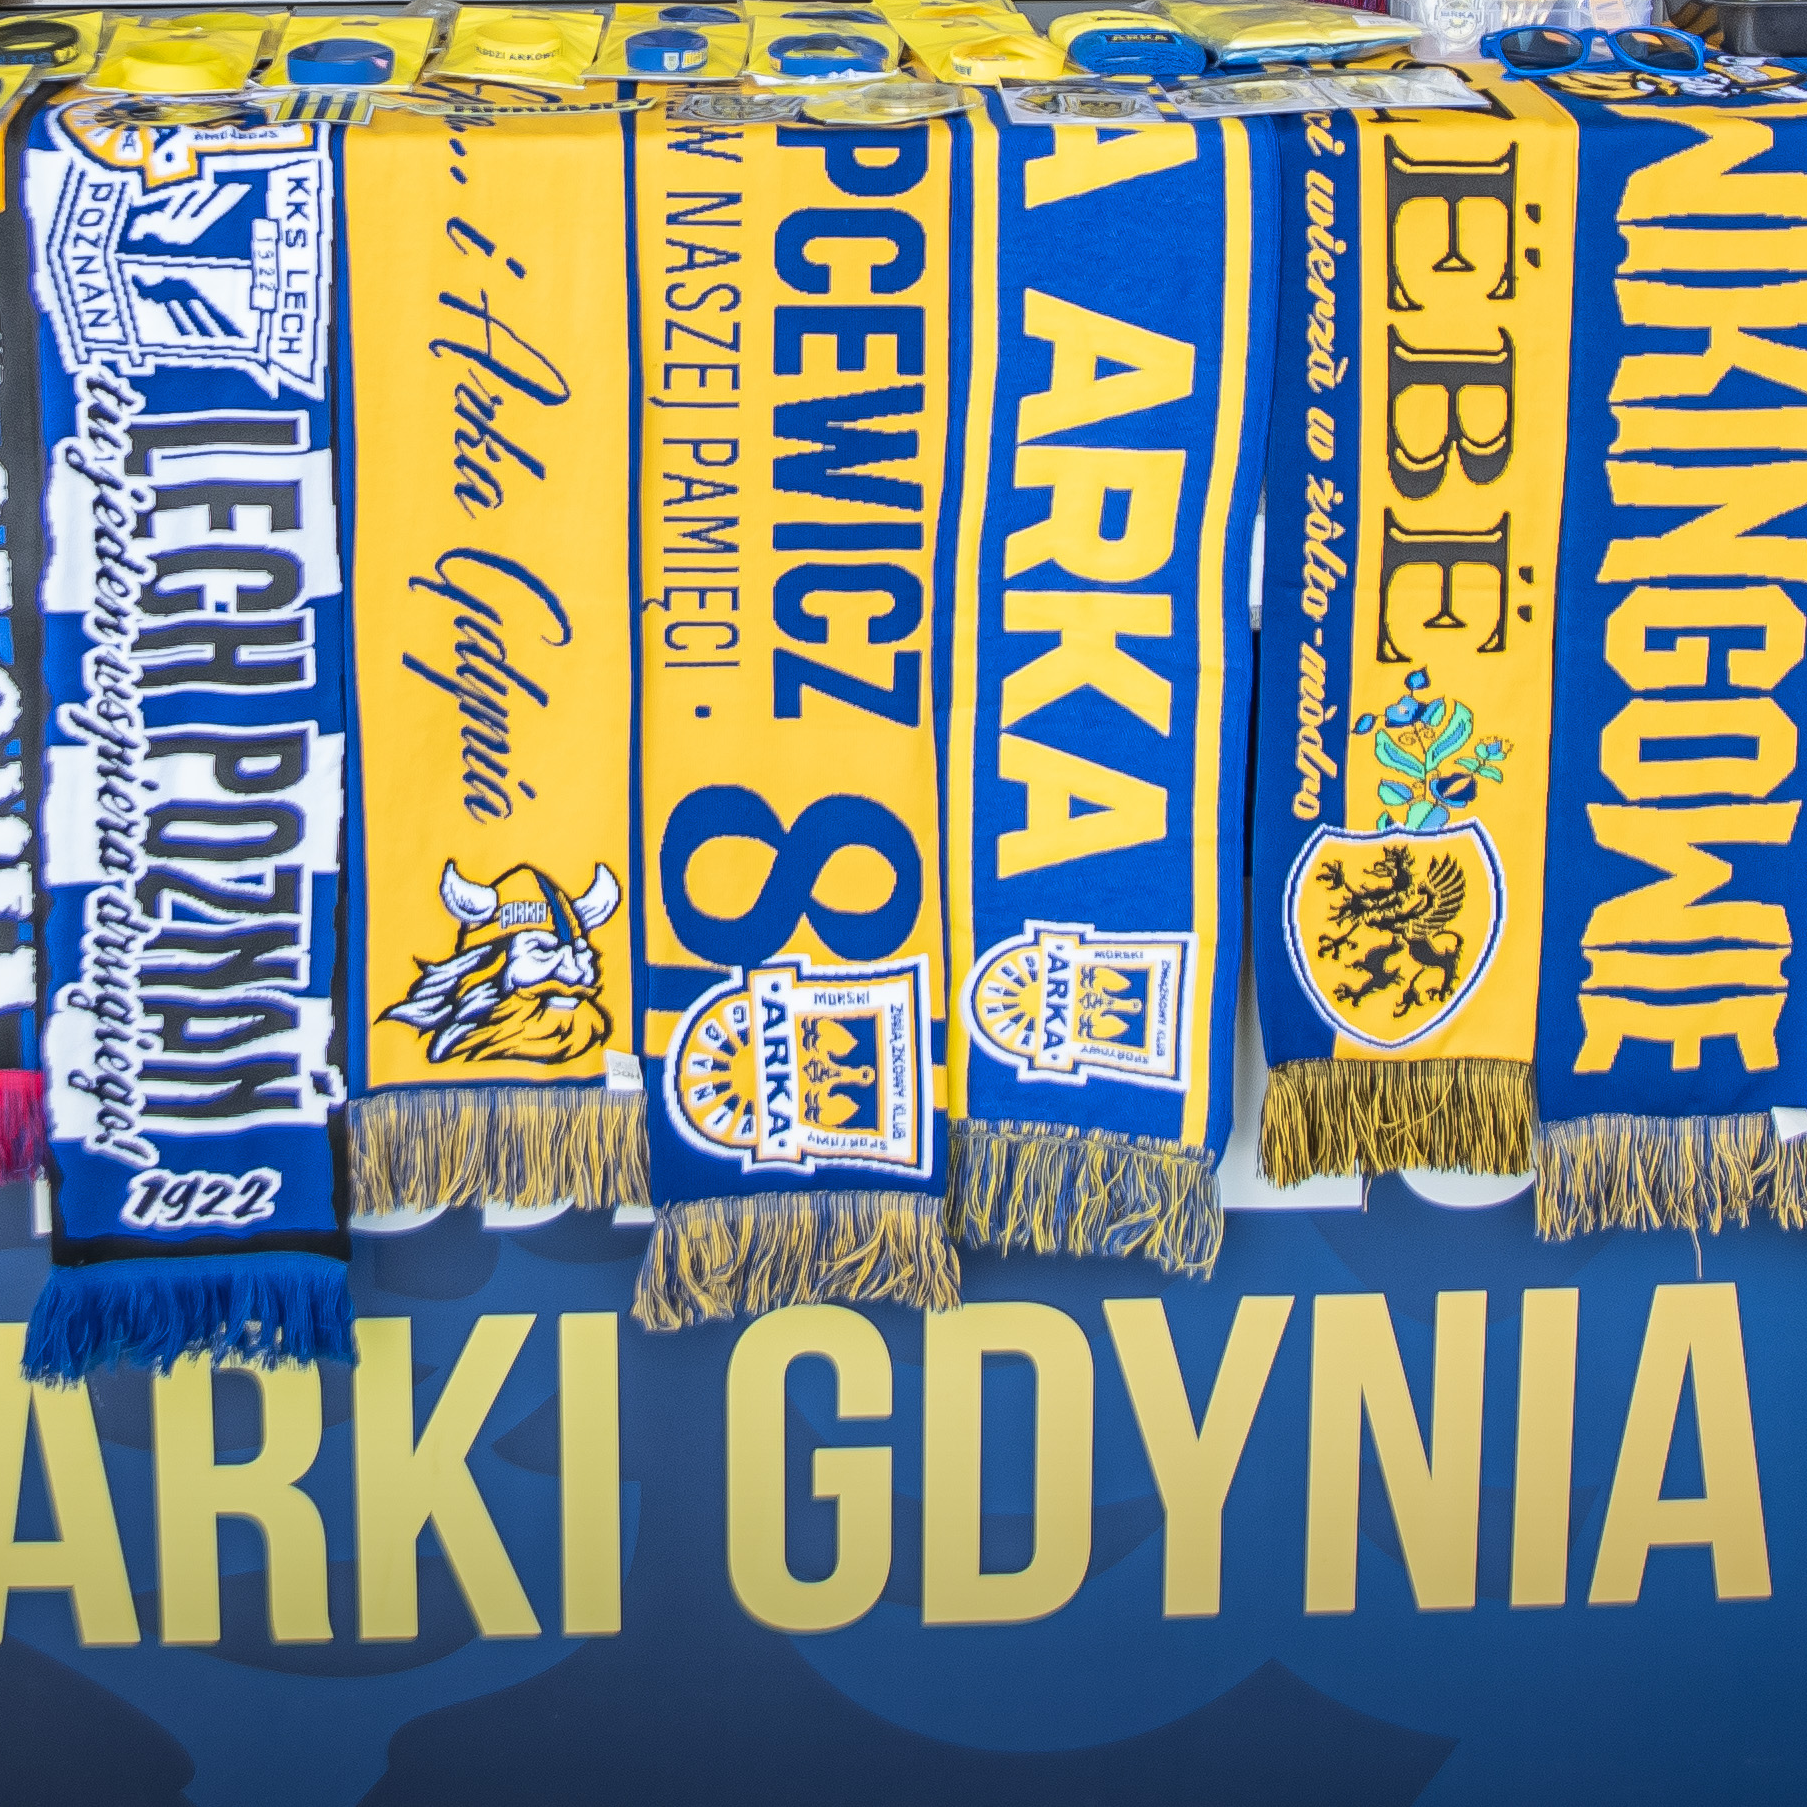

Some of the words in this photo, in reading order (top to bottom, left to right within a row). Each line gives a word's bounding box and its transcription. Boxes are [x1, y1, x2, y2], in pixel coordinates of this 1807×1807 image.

[285, 176, 311, 247] KKS
[446, 215, 527, 279] i
[647, 192, 742, 410] NASZEJ
[279, 269, 310, 355] LECH
[429, 290, 573, 519] Arka
[1376, 135, 1541, 664] ËBË
[86, 376, 134, 449] tu
[772, 125, 931, 728] PCEWICZ
[1306, 406, 1335, 461] w
[65, 445, 145, 635] jeden
[127, 413, 313, 689] LECH
[641, 438, 739, 668] PAMIĘCI
[998, 289, 1196, 880] ARKA
[69, 656, 158, 874] wspiera
[401, 546, 574, 825] Gdynia
[133, 733, 343, 1118] POZNAŃ
[500, 901, 548, 929] ARKA
[659, 784, 923, 969] 8
[1094, 950, 1146, 961] MORSKI
[68, 892, 159, 1158] drugiego!
[762, 998, 795, 1140] ARKA
[813, 990, 871, 1007] MORSKI
[1049, 955, 1067, 1053] ARKA
[127, 1172, 278, 1227] 1922
[725, 1288, 1773, 1633] GDYNIA
